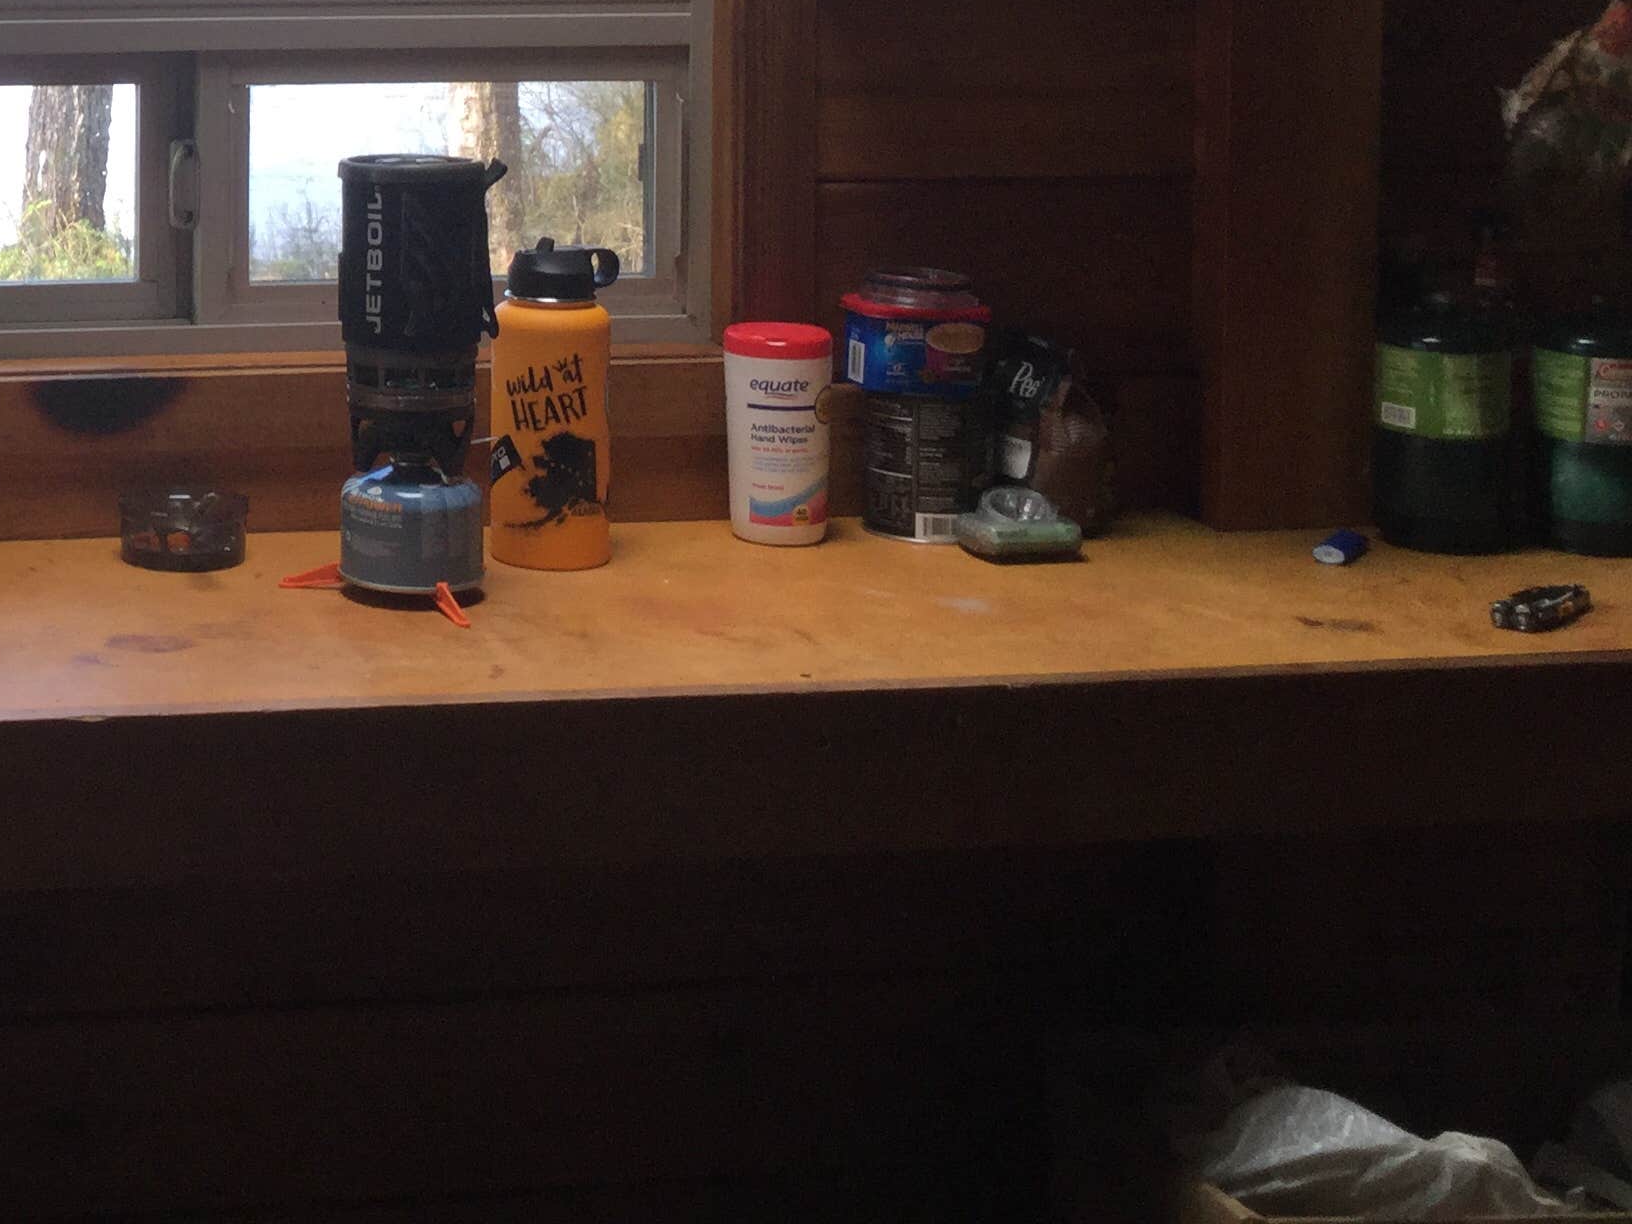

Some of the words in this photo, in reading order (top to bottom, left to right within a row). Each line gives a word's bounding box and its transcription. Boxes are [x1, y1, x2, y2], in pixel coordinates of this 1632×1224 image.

[364, 186, 383, 336] JETBOIL
[506, 366, 553, 398] wild
[750, 378, 808, 397] equate
[511, 386, 589, 432] HEART
[750, 423, 816, 434] Antibacterial
[751, 433, 776, 443] Hand
